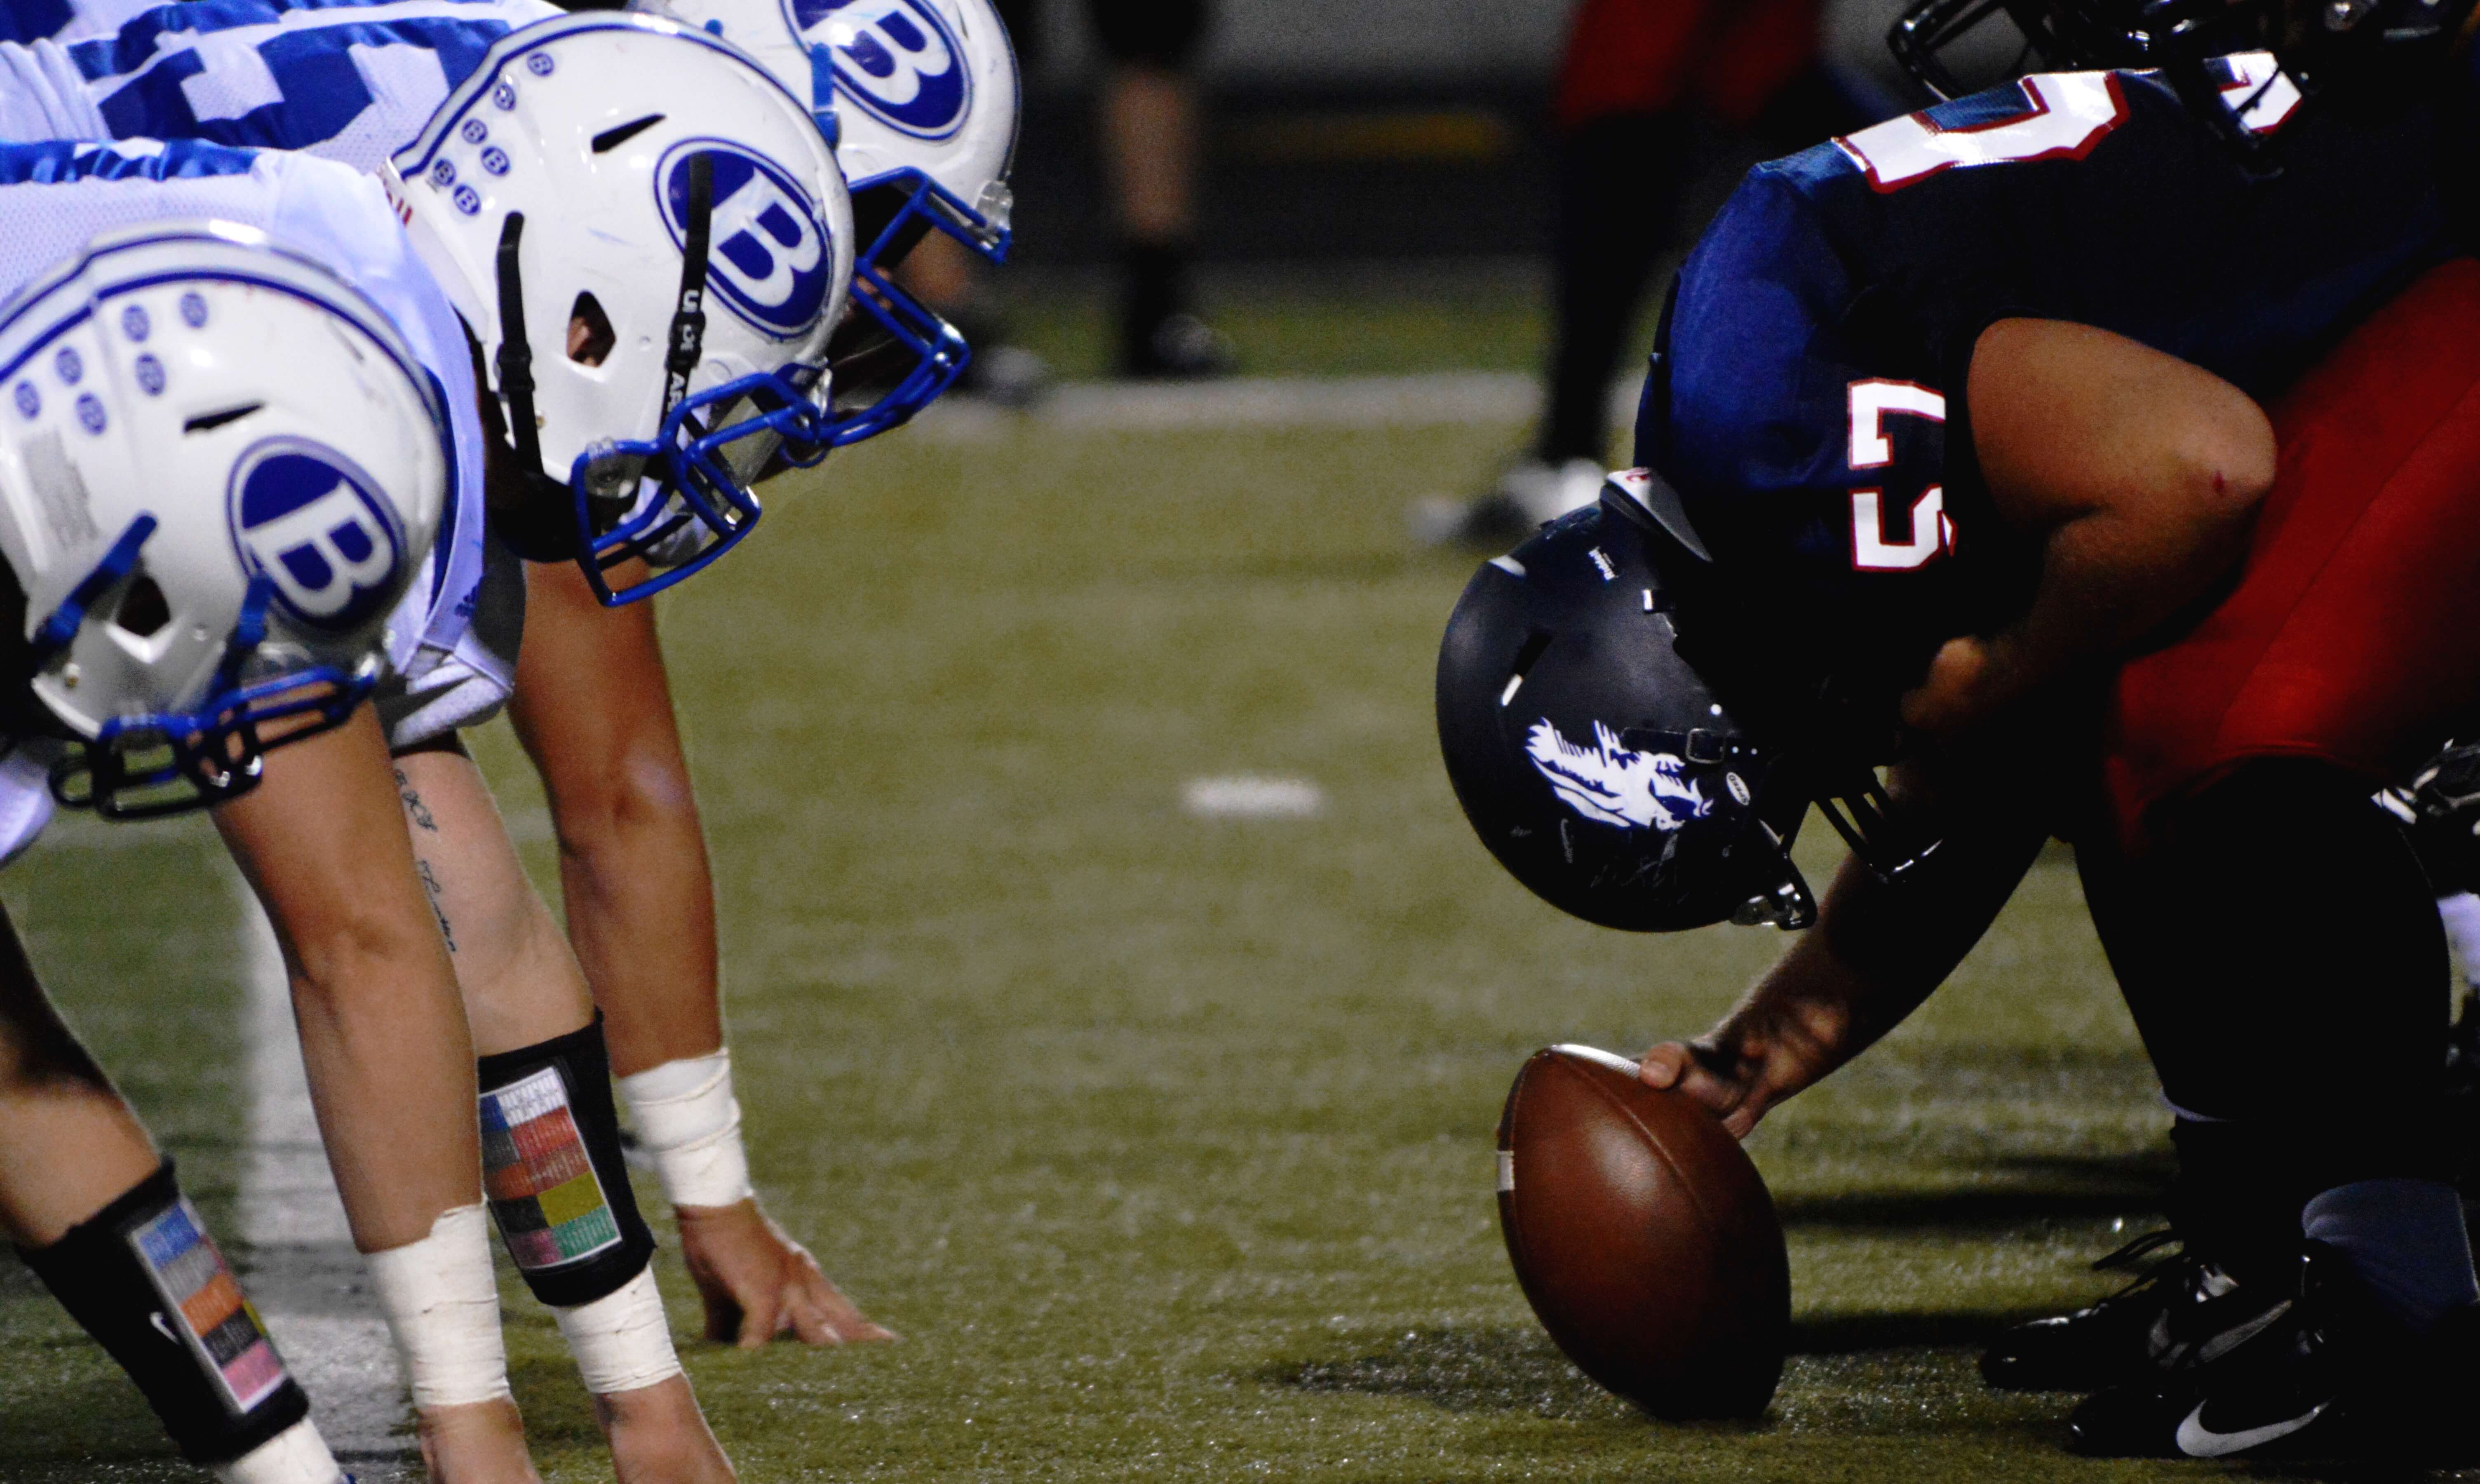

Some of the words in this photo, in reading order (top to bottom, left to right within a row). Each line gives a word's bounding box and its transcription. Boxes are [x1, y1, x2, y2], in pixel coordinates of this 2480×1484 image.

[801, 0, 951, 105] B
[455, 186, 479, 212] B
[482, 148, 509, 174] B
[706, 166, 821, 308] B
[242, 479, 393, 616] B
